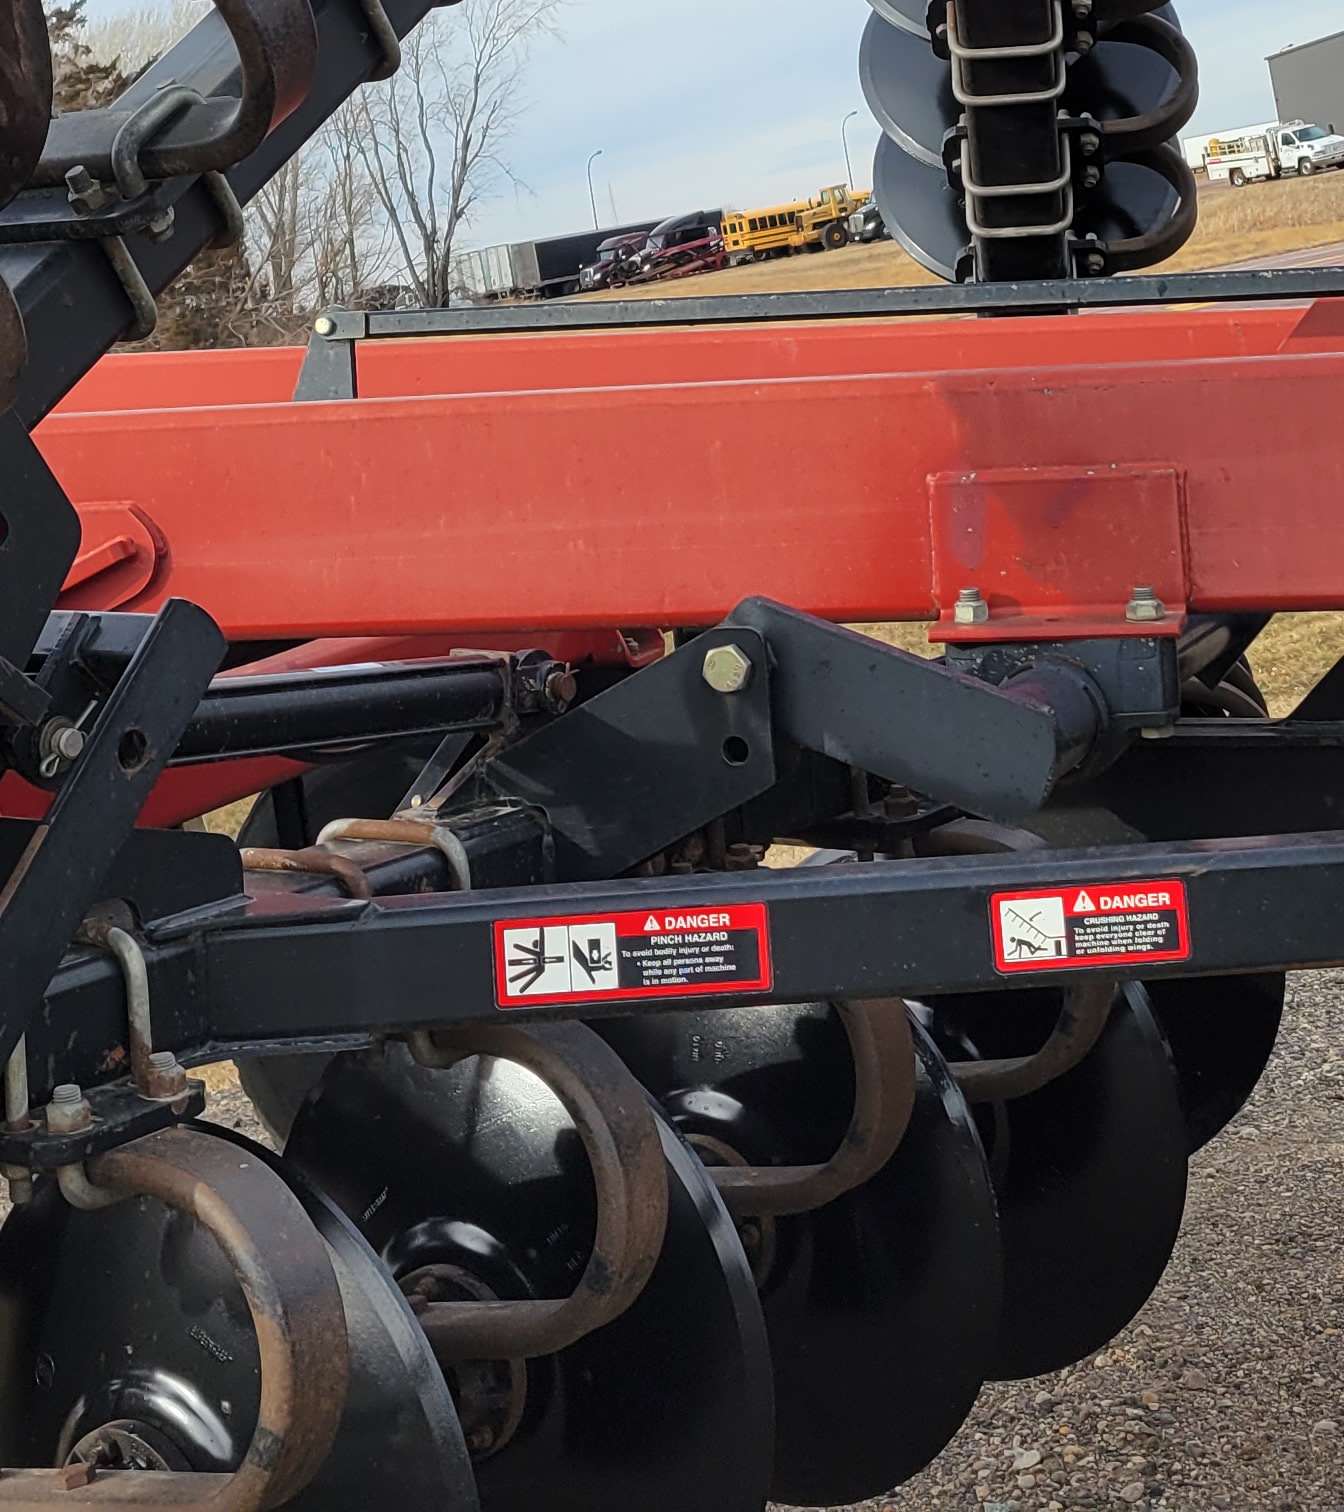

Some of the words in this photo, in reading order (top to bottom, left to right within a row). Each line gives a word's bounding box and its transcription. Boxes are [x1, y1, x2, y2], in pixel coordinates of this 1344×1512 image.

[1100, 893, 1170, 909] DANGER
[665, 914, 730, 929] DANGER
[1084, 915, 1124, 925] CRUSHING
[1126, 913, 1159, 921] HAZARD
[1111, 924, 1133, 932] injury
[651, 935, 682, 945] PINCH
[685, 932, 728, 943] HAZARD
[1096, 932, 1132, 940] everyone
[633, 949, 652, 957] avoid
[654, 948, 677, 956] bodily
[679, 947, 699, 955] injury
[674, 957, 703, 965] persons
[664, 968, 676, 976] any
[679, 967, 694, 975] part
[705, 964, 736, 972] machine
[661, 976, 689, 984] motion.
